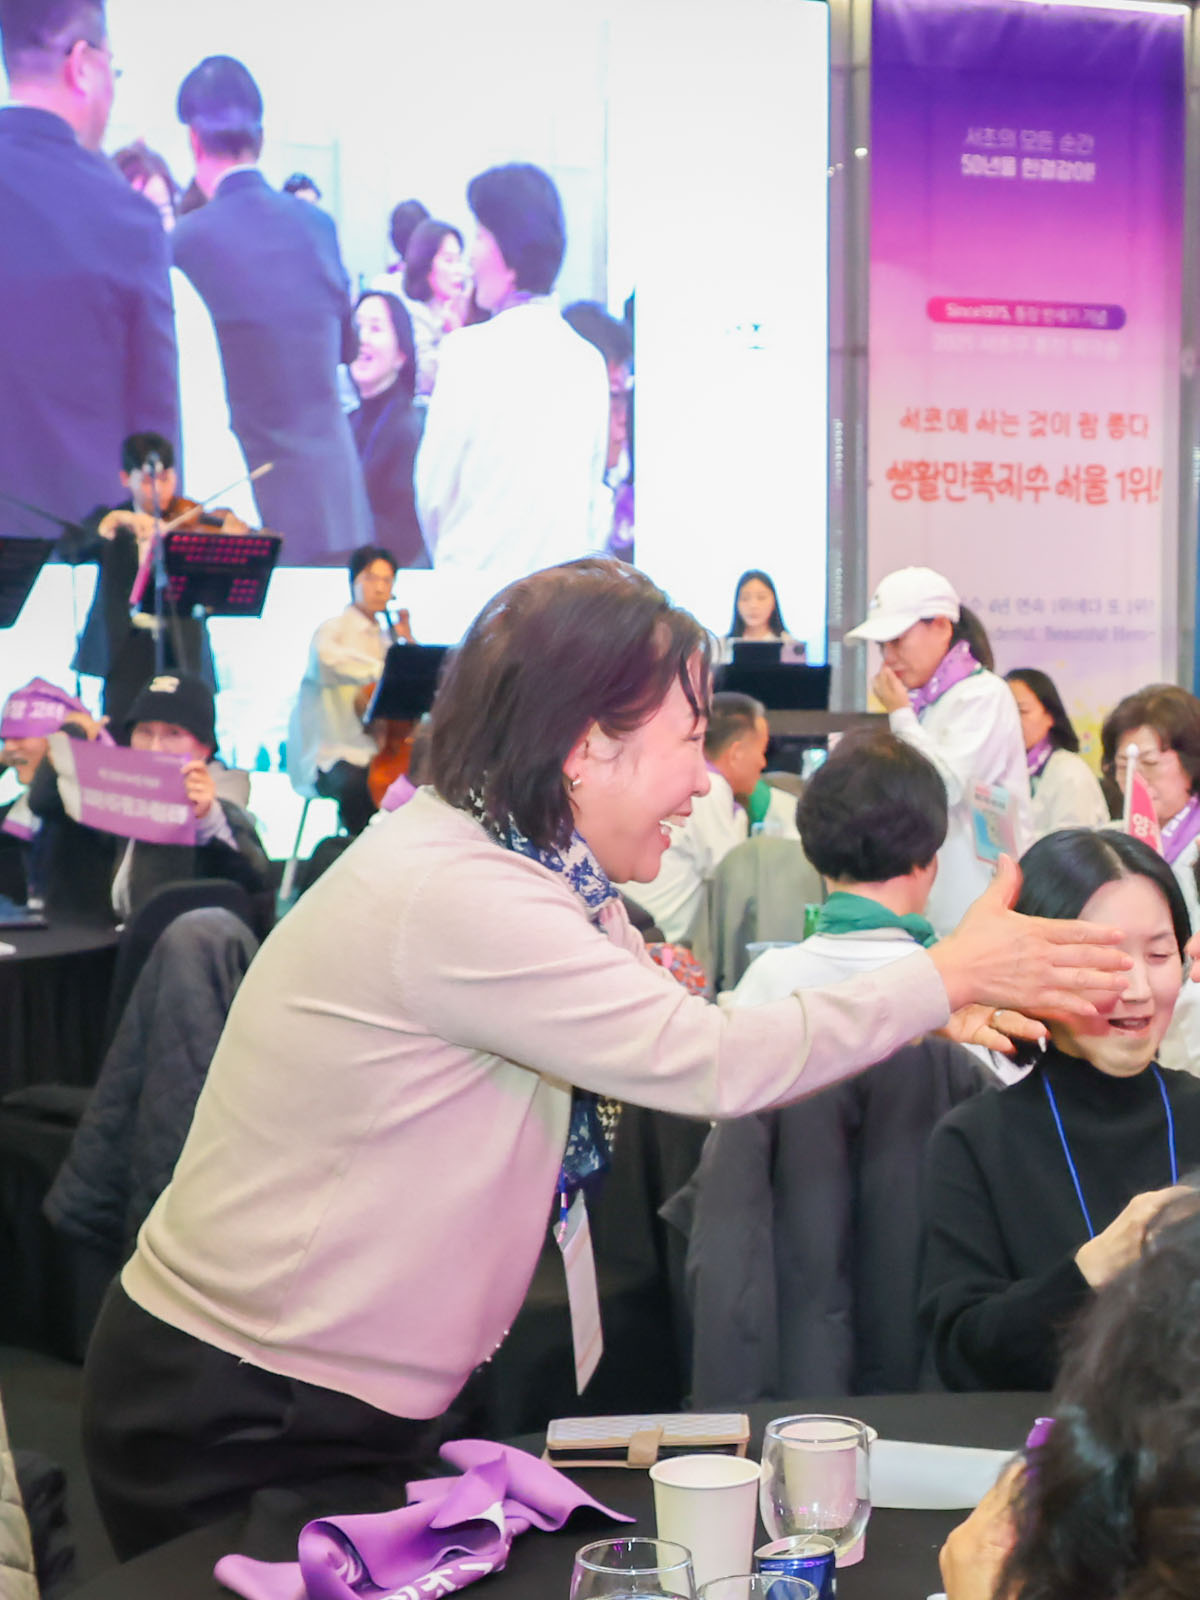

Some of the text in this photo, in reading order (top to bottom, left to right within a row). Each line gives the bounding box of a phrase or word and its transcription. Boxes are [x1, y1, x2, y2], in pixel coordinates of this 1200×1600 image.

[1020, 130, 1053, 152] 모든
[1059, 132, 1095, 154] 순간
[899, 406, 1150, 440] 서초에 사는 것이 참 좋다
[885, 459, 1163, 505] 생활만족지수 서울 1위!
